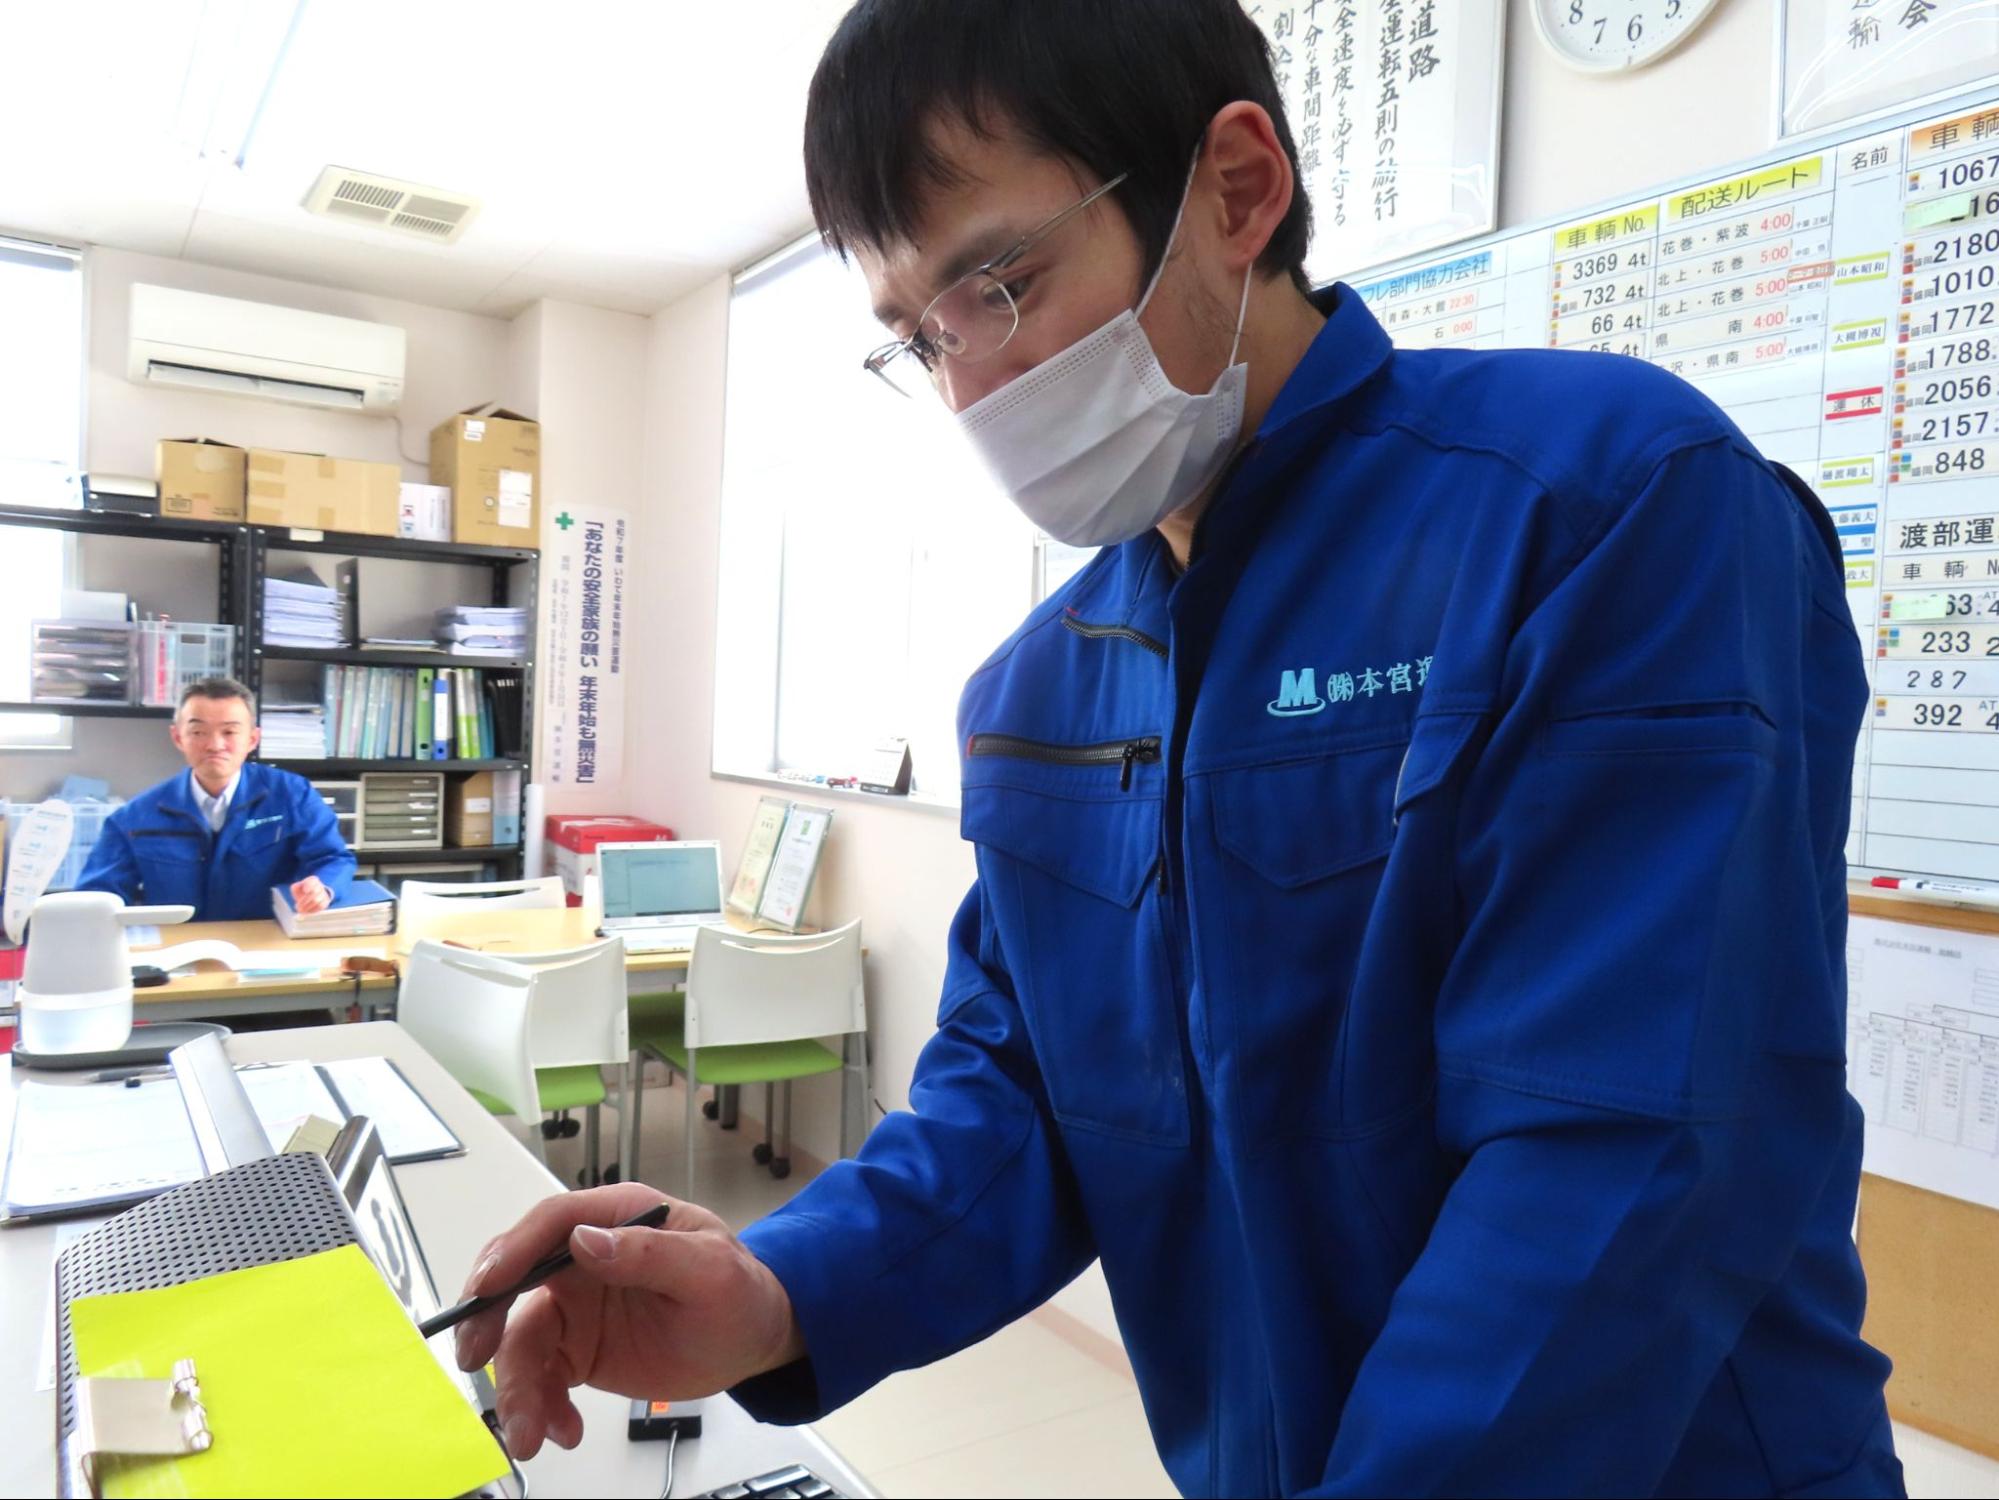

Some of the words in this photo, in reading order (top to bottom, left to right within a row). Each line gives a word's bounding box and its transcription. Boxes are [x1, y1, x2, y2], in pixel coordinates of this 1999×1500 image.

[1569, 0, 1583, 25] 8
[1898, 0, 1937, 29] 会
[1407, 0, 1440, 82] 道路
[1594, 18, 1608, 44] 7
[1627, 14, 1643, 42] 6
[1332, 0, 1356, 227] 全速度を必ず守る
[1851, 146, 1889, 171] 名前
[1939, 154, 1999, 189] 1067
[1681, 167, 1808, 218] 配送ルート
[1623, 215, 1646, 235] No.
[1761, 213, 1790, 231] 4:00
[1933, 229, 1999, 264] 2180
[1573, 253, 1618, 280] 3369
[1628, 253, 1647, 268] 4t
[1658, 256, 1744, 287] 北上・花巻
[1760, 247, 1789, 264] 5:00
[1932, 265, 1994, 297] 1010
[1584, 284, 1616, 308] 732
[1625, 285, 1644, 299] 4t
[1657, 287, 1744, 318] 北上・花巻
[1755, 278, 1786, 297] 5:00
[1591, 313, 1614, 335] 66
[1623, 314, 1642, 330] 4t
[1753, 311, 1784, 328] 4:00
[1929, 302, 1994, 333] 1772
[1661, 350, 1739, 373] 沢・県南
[1755, 343, 1784, 359] 5:00
[1925, 338, 1990, 369] 1788
[1925, 375, 1991, 405] 2056
[1922, 411, 1989, 441] 2157
[1935, 448, 1985, 474] 848
[1900, 517, 1994, 549] 渡部運
[1921, 631, 1971, 653] 233
[1277, 668, 1317, 708] M
[1907, 670, 1967, 690] 287
[1913, 704, 1962, 726] 392
